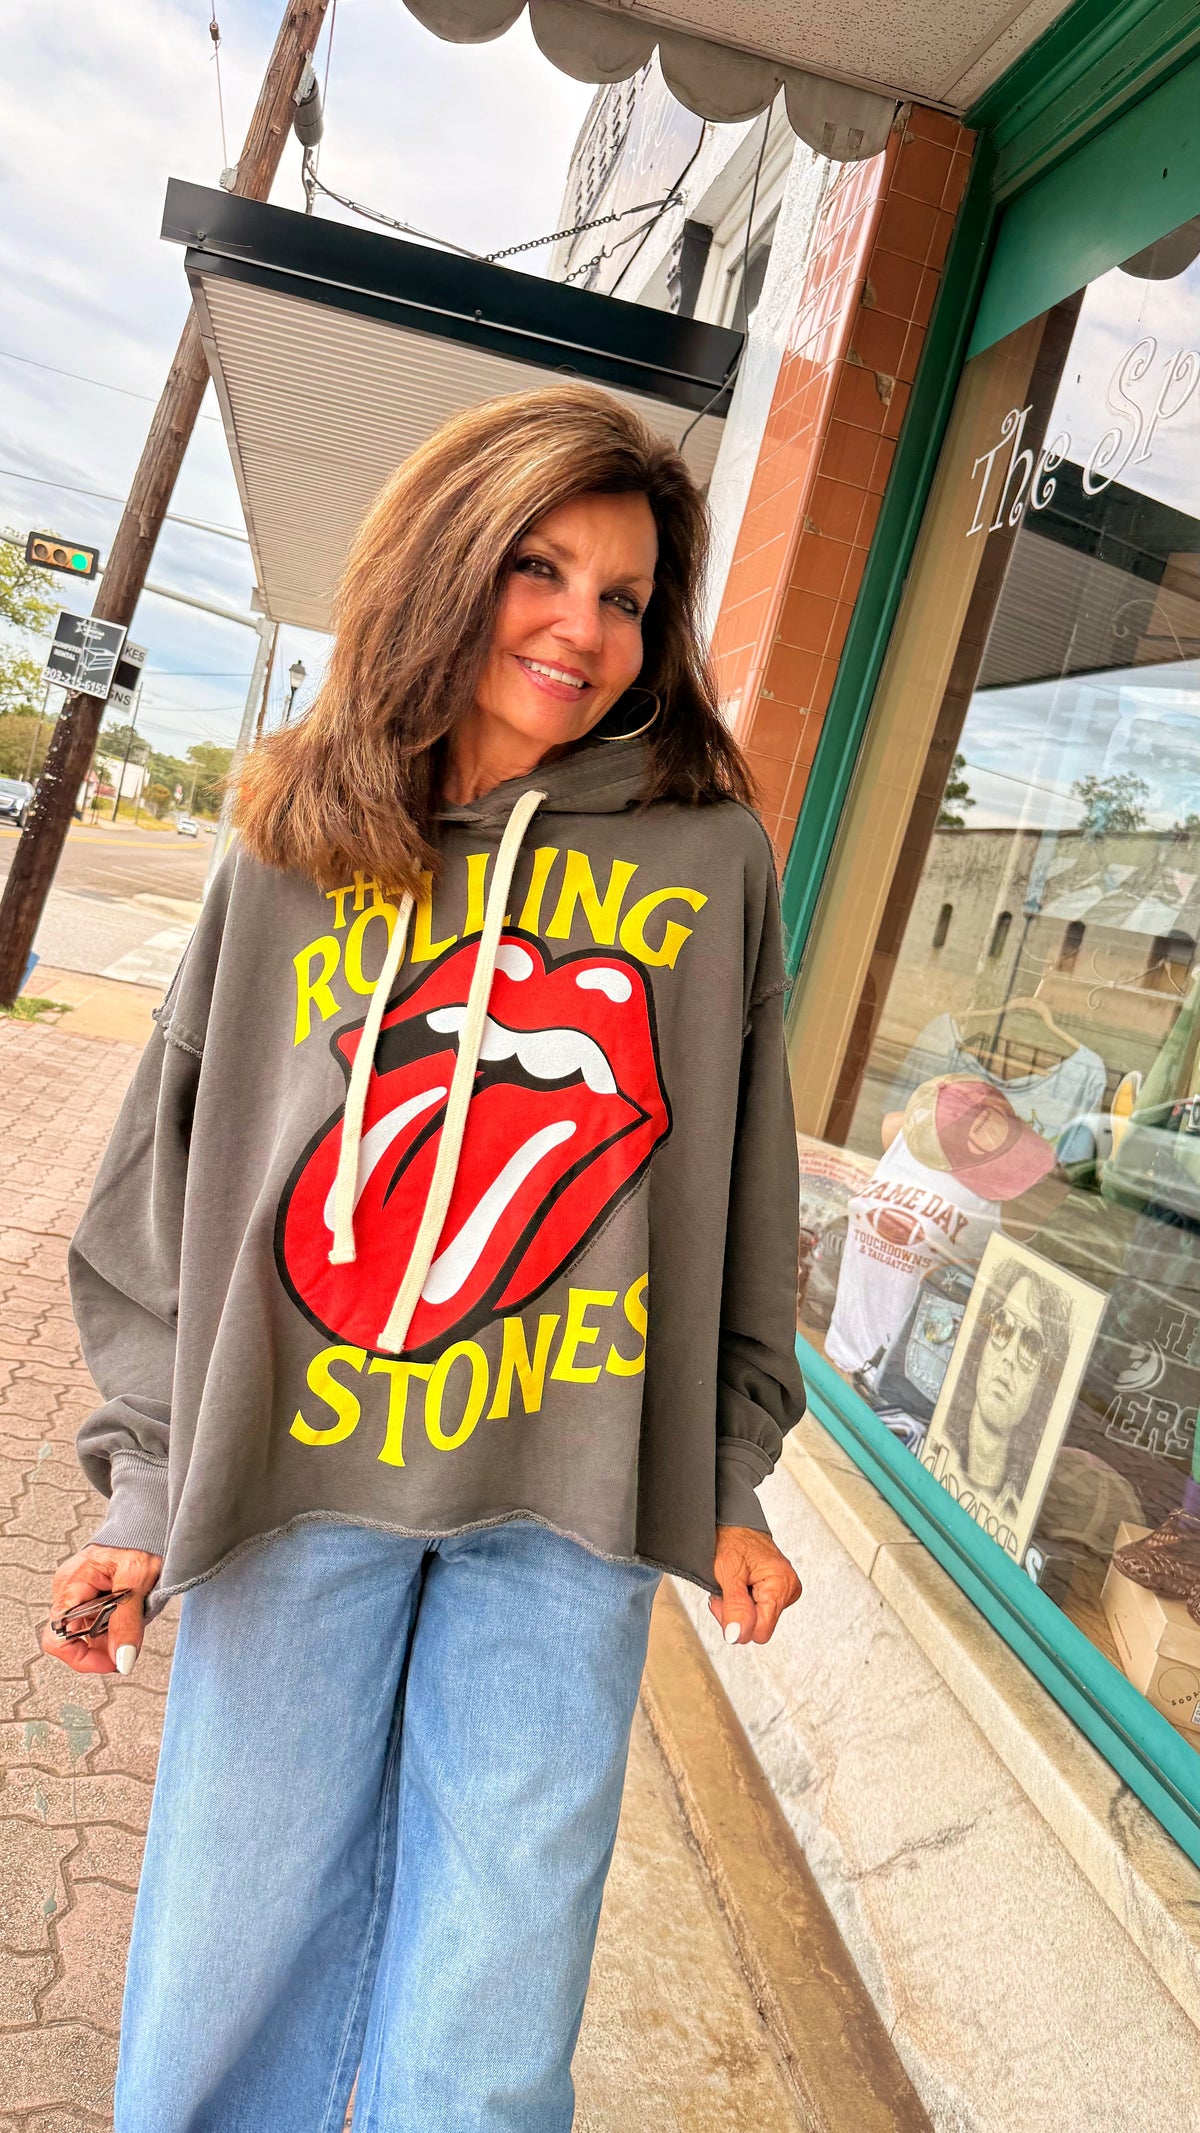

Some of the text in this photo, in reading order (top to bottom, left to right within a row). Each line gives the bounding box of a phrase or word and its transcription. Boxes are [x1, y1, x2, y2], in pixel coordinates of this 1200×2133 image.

[966, 403, 1071, 537] The
[53, 648, 76, 661] RENTAL
[292, 846, 709, 1047] ROLLING
[921, 1194, 969, 1246] DAY
[854, 1228, 932, 1268] TOUCHDOWNS
[859, 1245, 914, 1274] & TAILGATES
[289, 1271, 649, 1468] STONES
